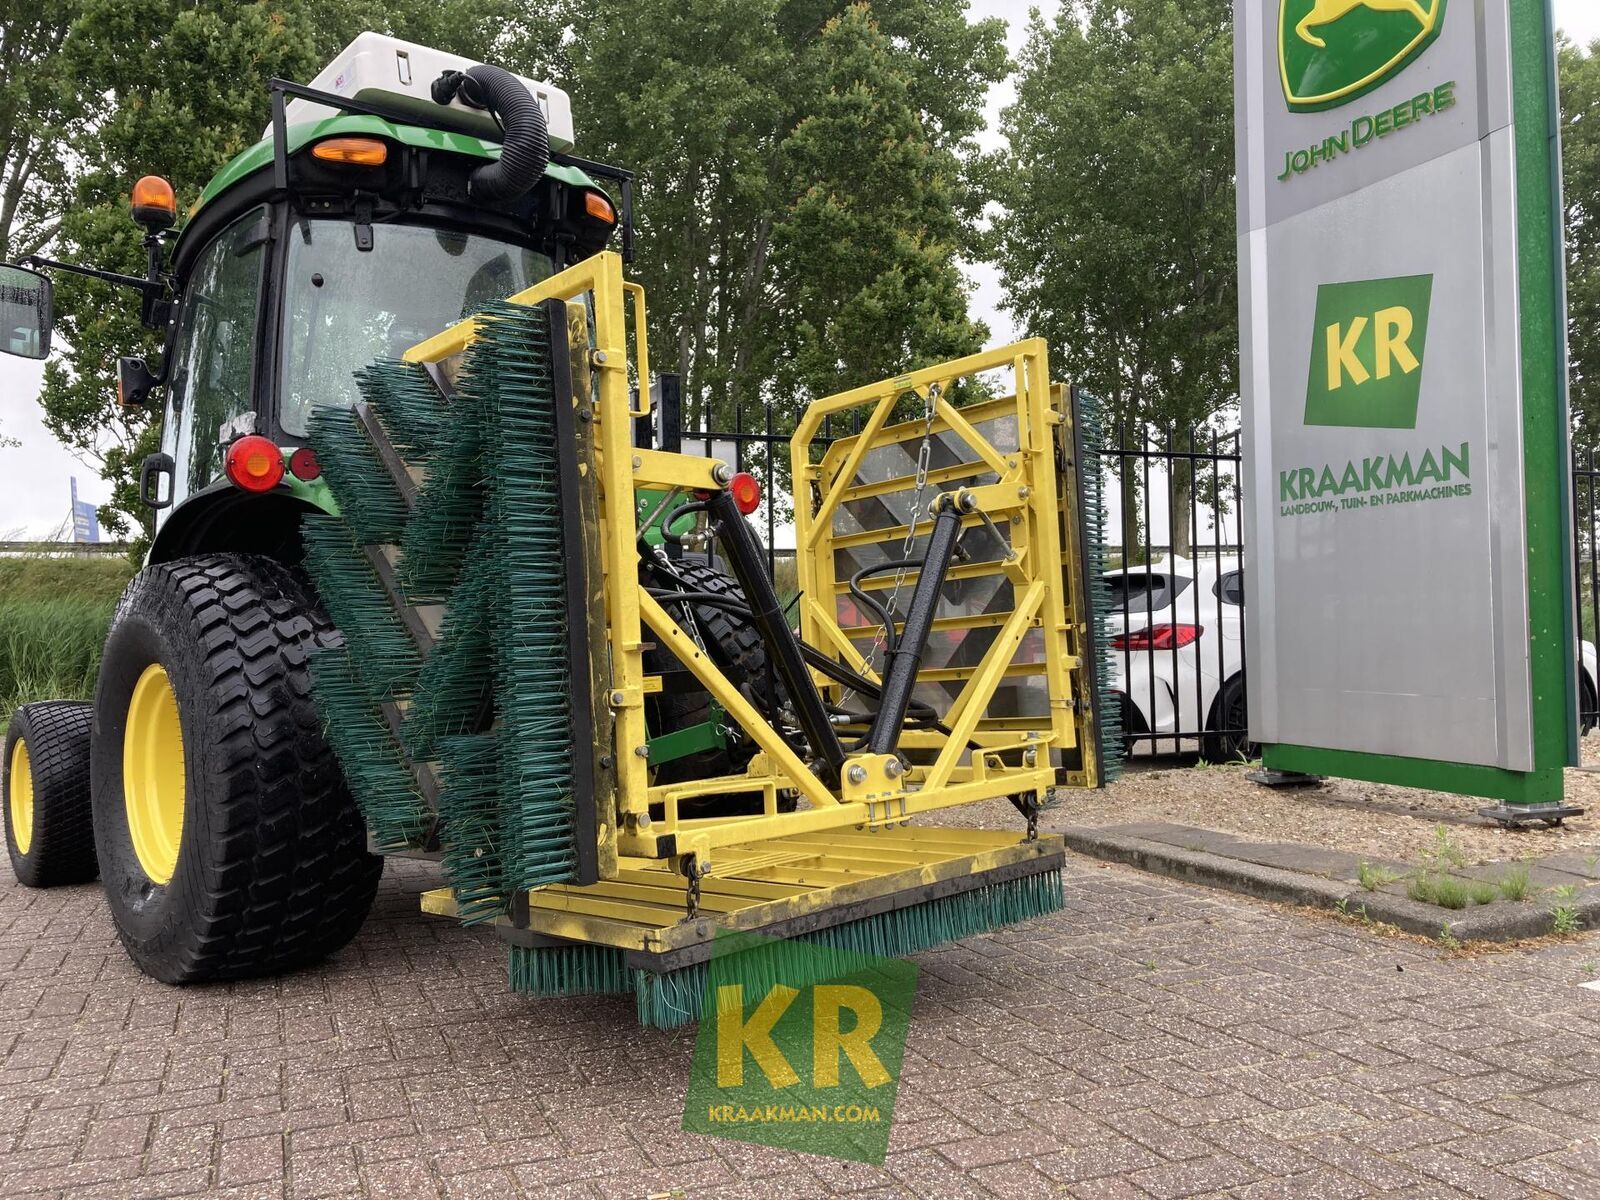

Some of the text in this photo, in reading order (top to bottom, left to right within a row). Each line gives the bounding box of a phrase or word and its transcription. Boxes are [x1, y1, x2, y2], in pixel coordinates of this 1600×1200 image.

[1277, 80, 1456, 181] JOHN DEERE
[1326, 305, 1420, 391] KR
[1279, 441, 1470, 502] KRAAKMAN
[1340, 496, 1368, 510] TUIN-
[1369, 494, 1384, 507] EN
[1386, 483, 1472, 505] PARKMACHINES
